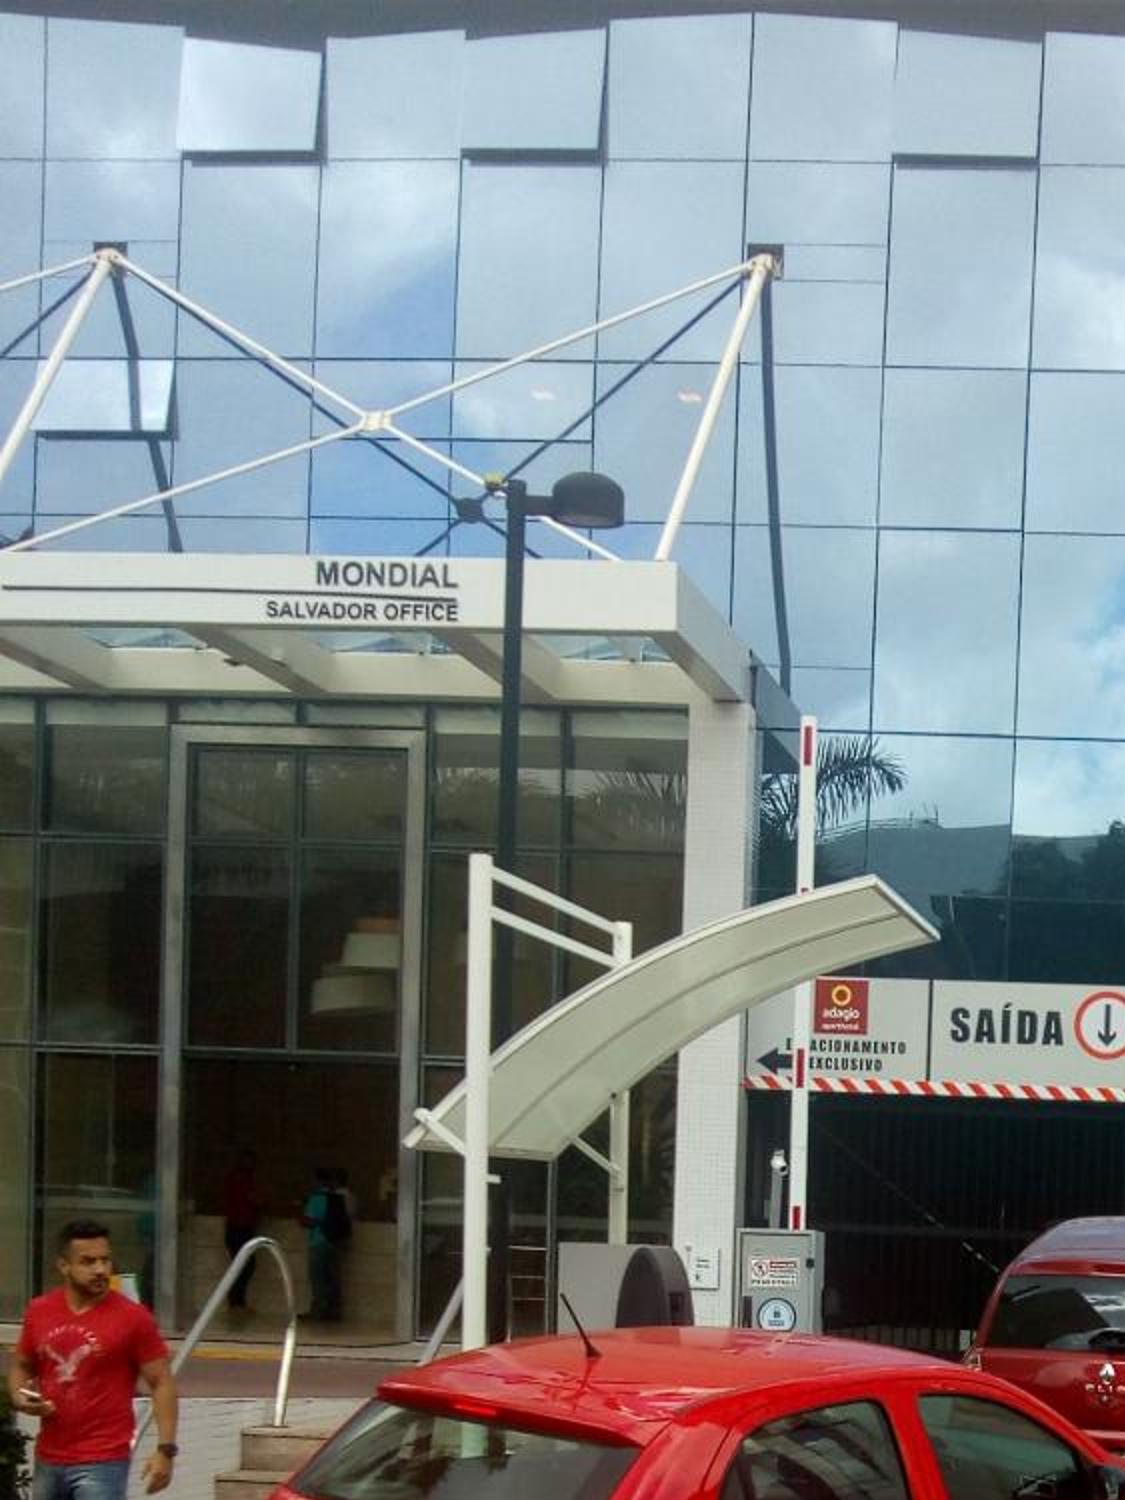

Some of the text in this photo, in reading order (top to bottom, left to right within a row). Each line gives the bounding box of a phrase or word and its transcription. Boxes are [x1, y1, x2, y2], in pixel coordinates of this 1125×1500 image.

[316, 561, 458, 588] MONDIAL
[267, 600, 459, 622] SALVADOR OFFICE
[822, 1006, 861, 1021] adagio
[950, 1002, 1064, 1046] SAÍDA
[786, 1037, 907, 1054] EACIONAMENTO
[809, 1057, 883, 1071] EXCLUSIVO
